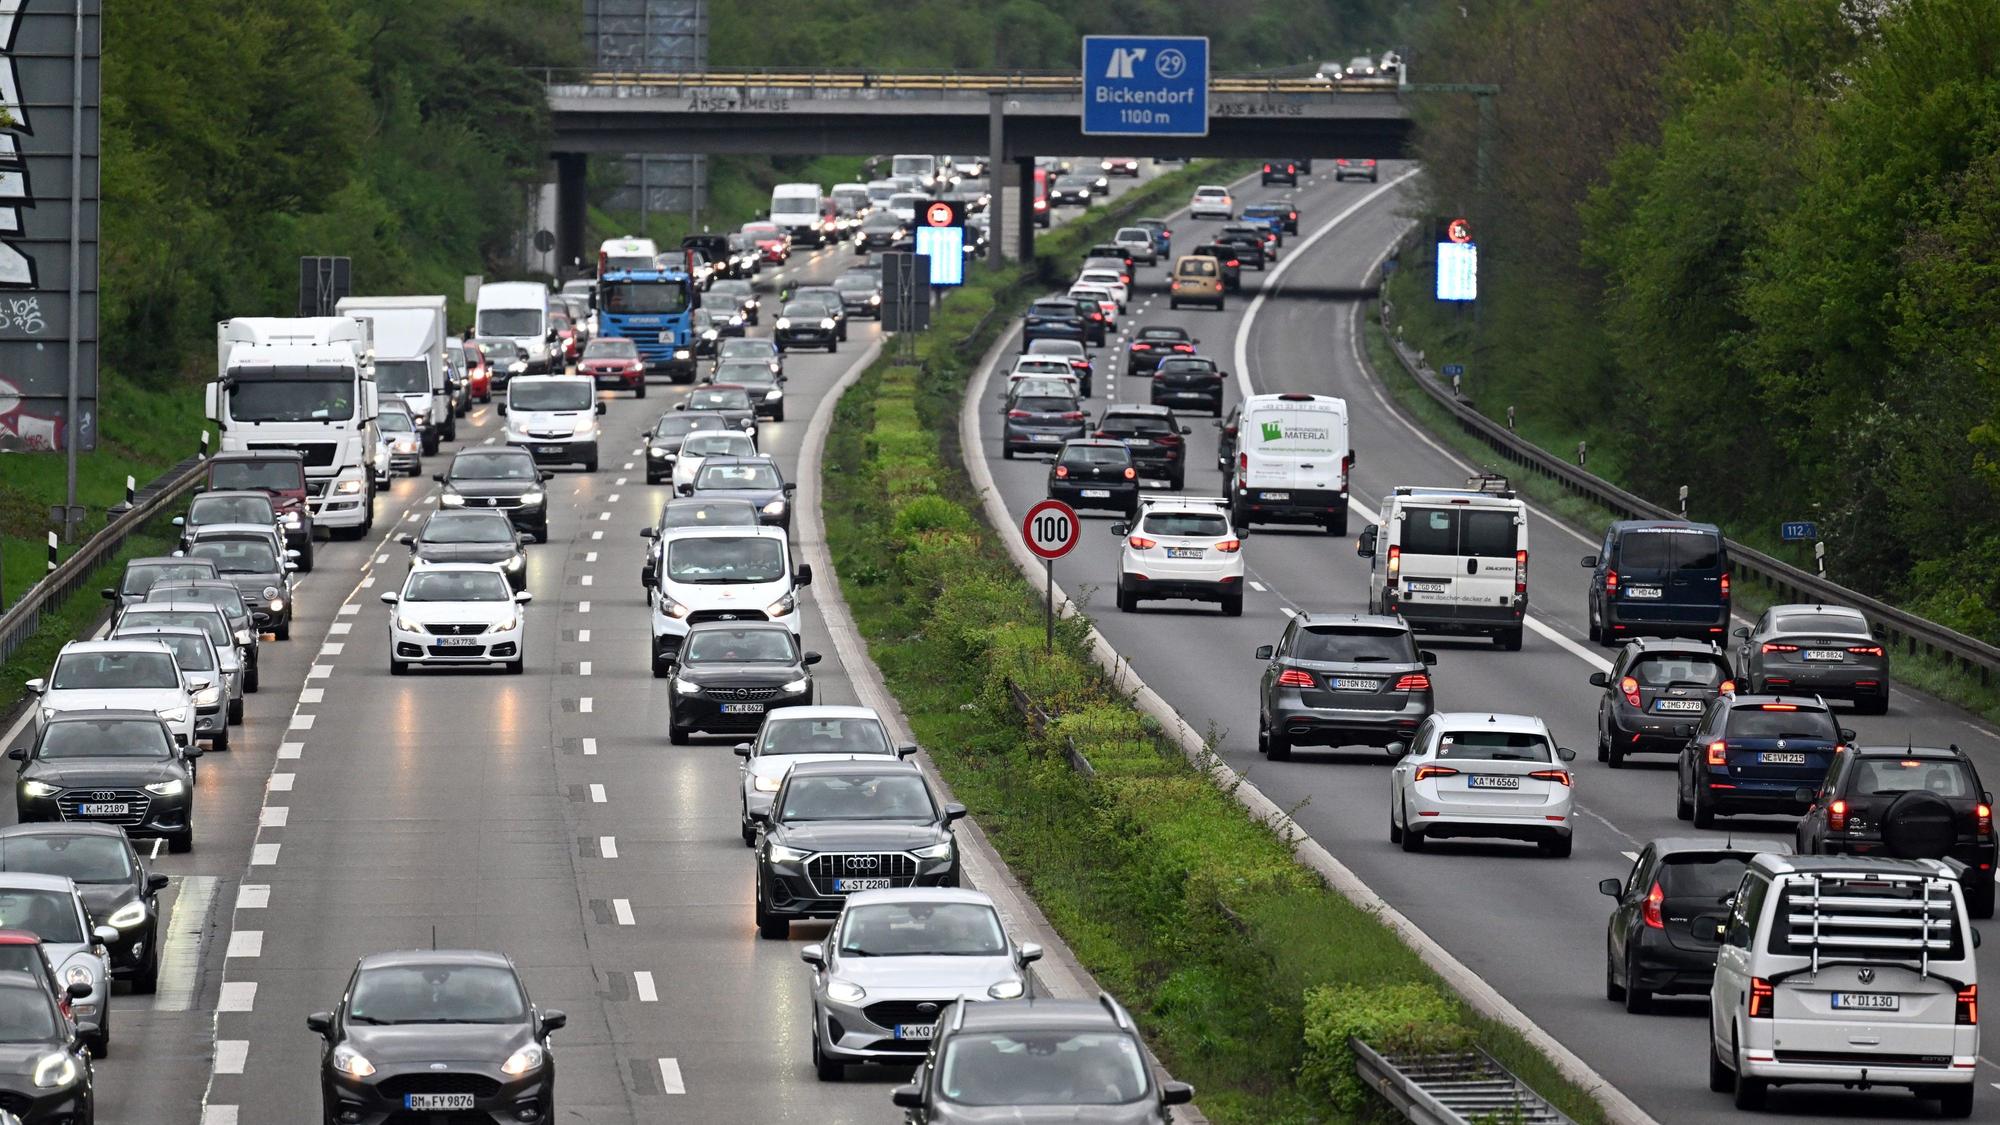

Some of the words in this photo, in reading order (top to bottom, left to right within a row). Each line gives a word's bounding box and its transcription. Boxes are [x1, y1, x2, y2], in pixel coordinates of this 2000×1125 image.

[1160, 56, 1181, 72] 29
[1096, 86, 1194, 103] Bickendorf
[1120, 109, 1152, 124] 1100
[1155, 113, 1170, 124] m
[1284, 431, 1325, 440] MATERLA
[1035, 516, 1068, 542] 100
[1682, 701, 1700, 709] 7378
[1497, 777, 1517, 787] 6566
[852, 880, 864, 889] ST
[866, 879, 888, 889] 2280
[1872, 996, 1893, 1006] 130
[411, 1096, 424, 1107] BM
[432, 1096, 445, 1107] FY
[447, 1096, 473, 1107] 9876
